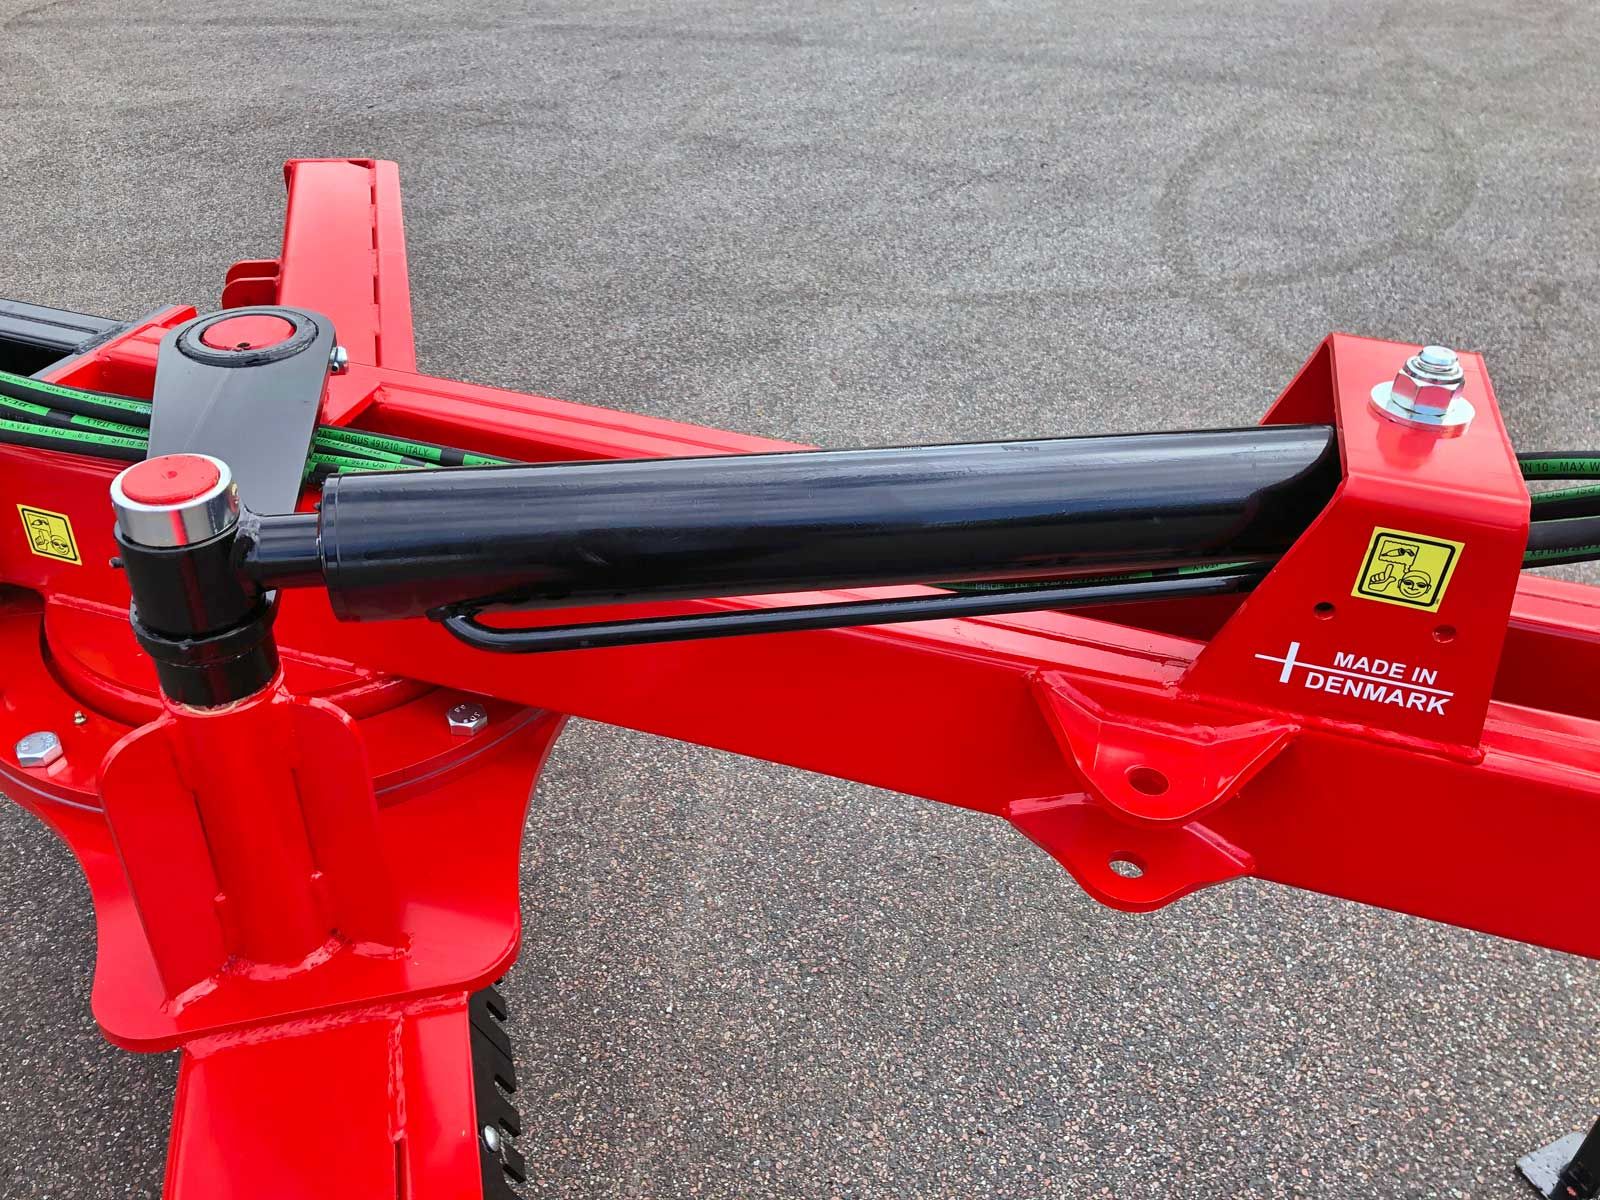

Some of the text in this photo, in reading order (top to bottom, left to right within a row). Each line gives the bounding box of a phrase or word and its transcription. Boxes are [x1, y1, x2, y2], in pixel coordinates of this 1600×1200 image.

[86, 418, 111, 429] ITALY
[338, 433, 369, 446] ARGUS
[404, 441, 428, 455] ITALY
[1537, 462, 1549, 472] 10
[1560, 461, 1585, 472] MAX
[1333, 652, 1438, 685] MADE IN
[1304, 672, 1450, 715] DENMARK
